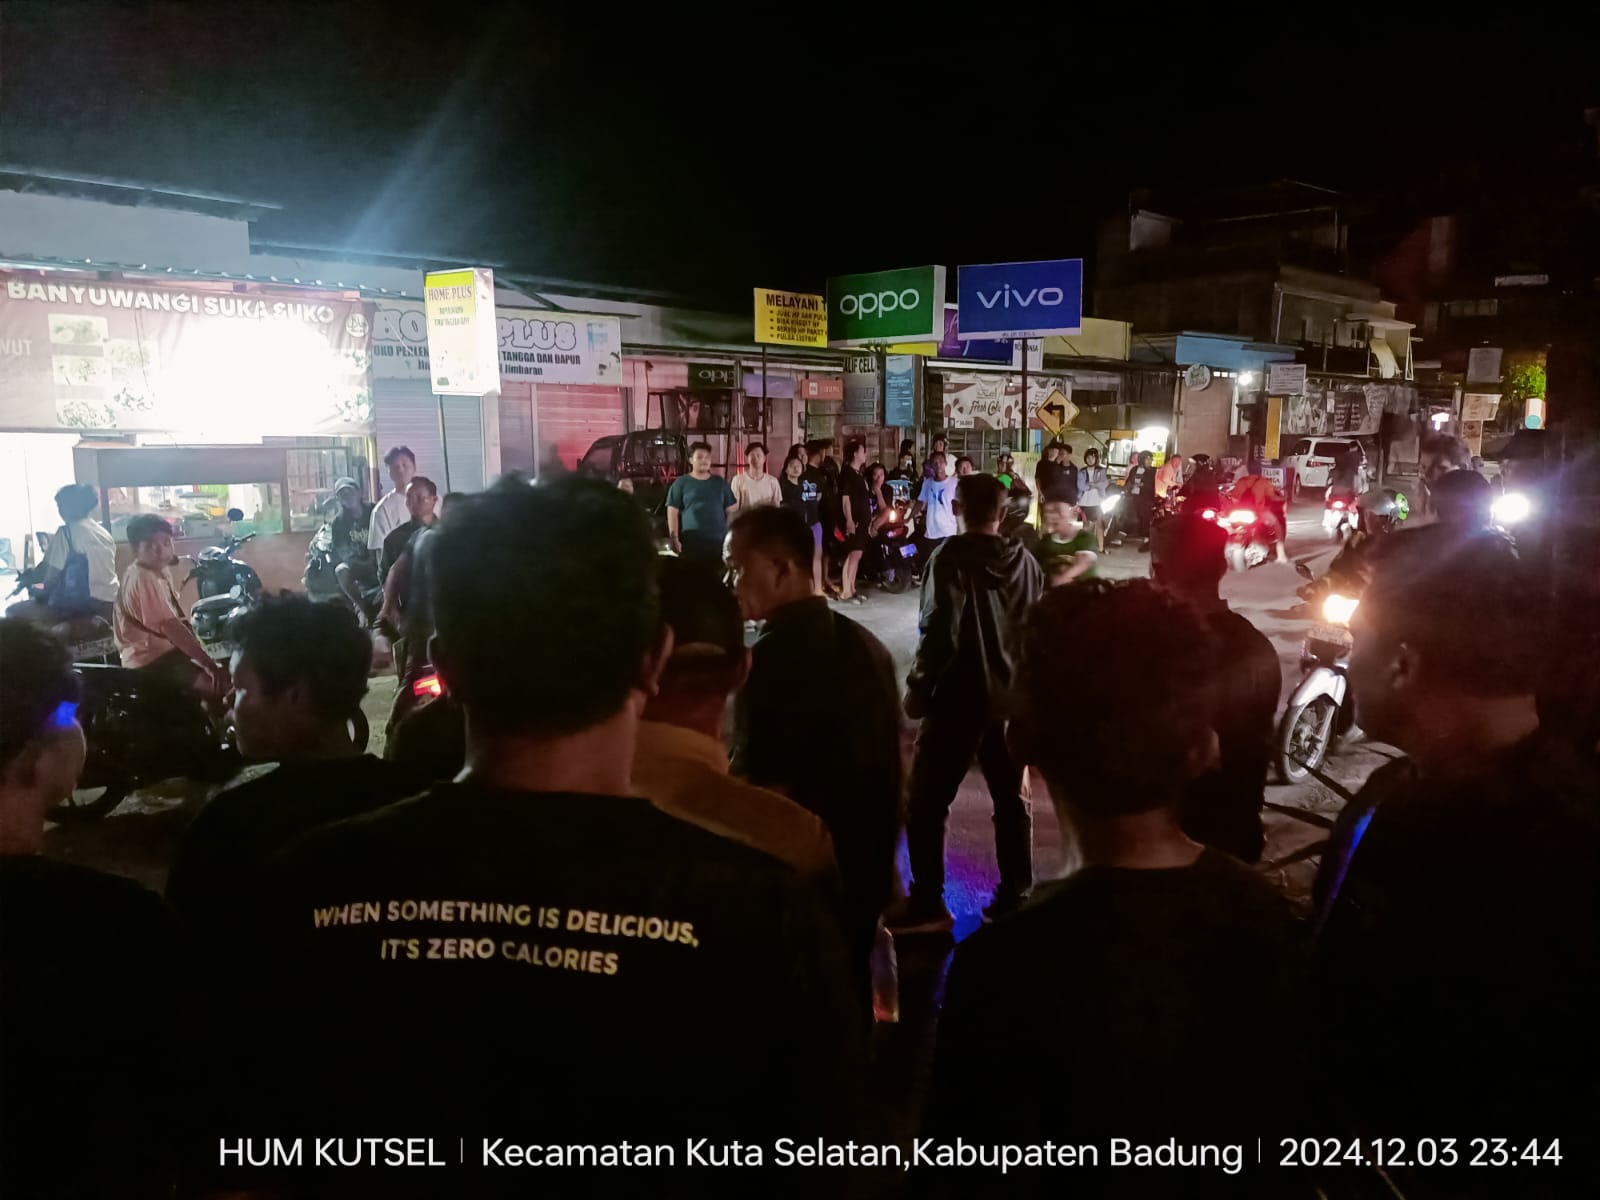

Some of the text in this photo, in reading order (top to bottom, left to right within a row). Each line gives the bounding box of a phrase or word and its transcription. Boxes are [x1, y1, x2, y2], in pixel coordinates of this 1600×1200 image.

[7, 280, 200, 314] BANYUWANGI
[203, 296, 268, 319] SUKA
[428, 285, 472, 302] HOME PLUS
[766, 293, 818, 311] MELAYANI
[839, 288, 920, 321] oppo
[976, 284, 1064, 309] vivo
[496, 316, 577, 351] PLUS
[374, 345, 394, 357] OKO
[502, 351, 535, 362] TANGGA
[536, 353, 553, 364] DAN
[859, 357, 875, 373] CELL
[505, 364, 543, 375] Jimbaran
[313, 899, 700, 948] WHEN SOMETHING IS DELICIOUS,
[381, 938, 619, 975] IT'S ZERO CALORIES
